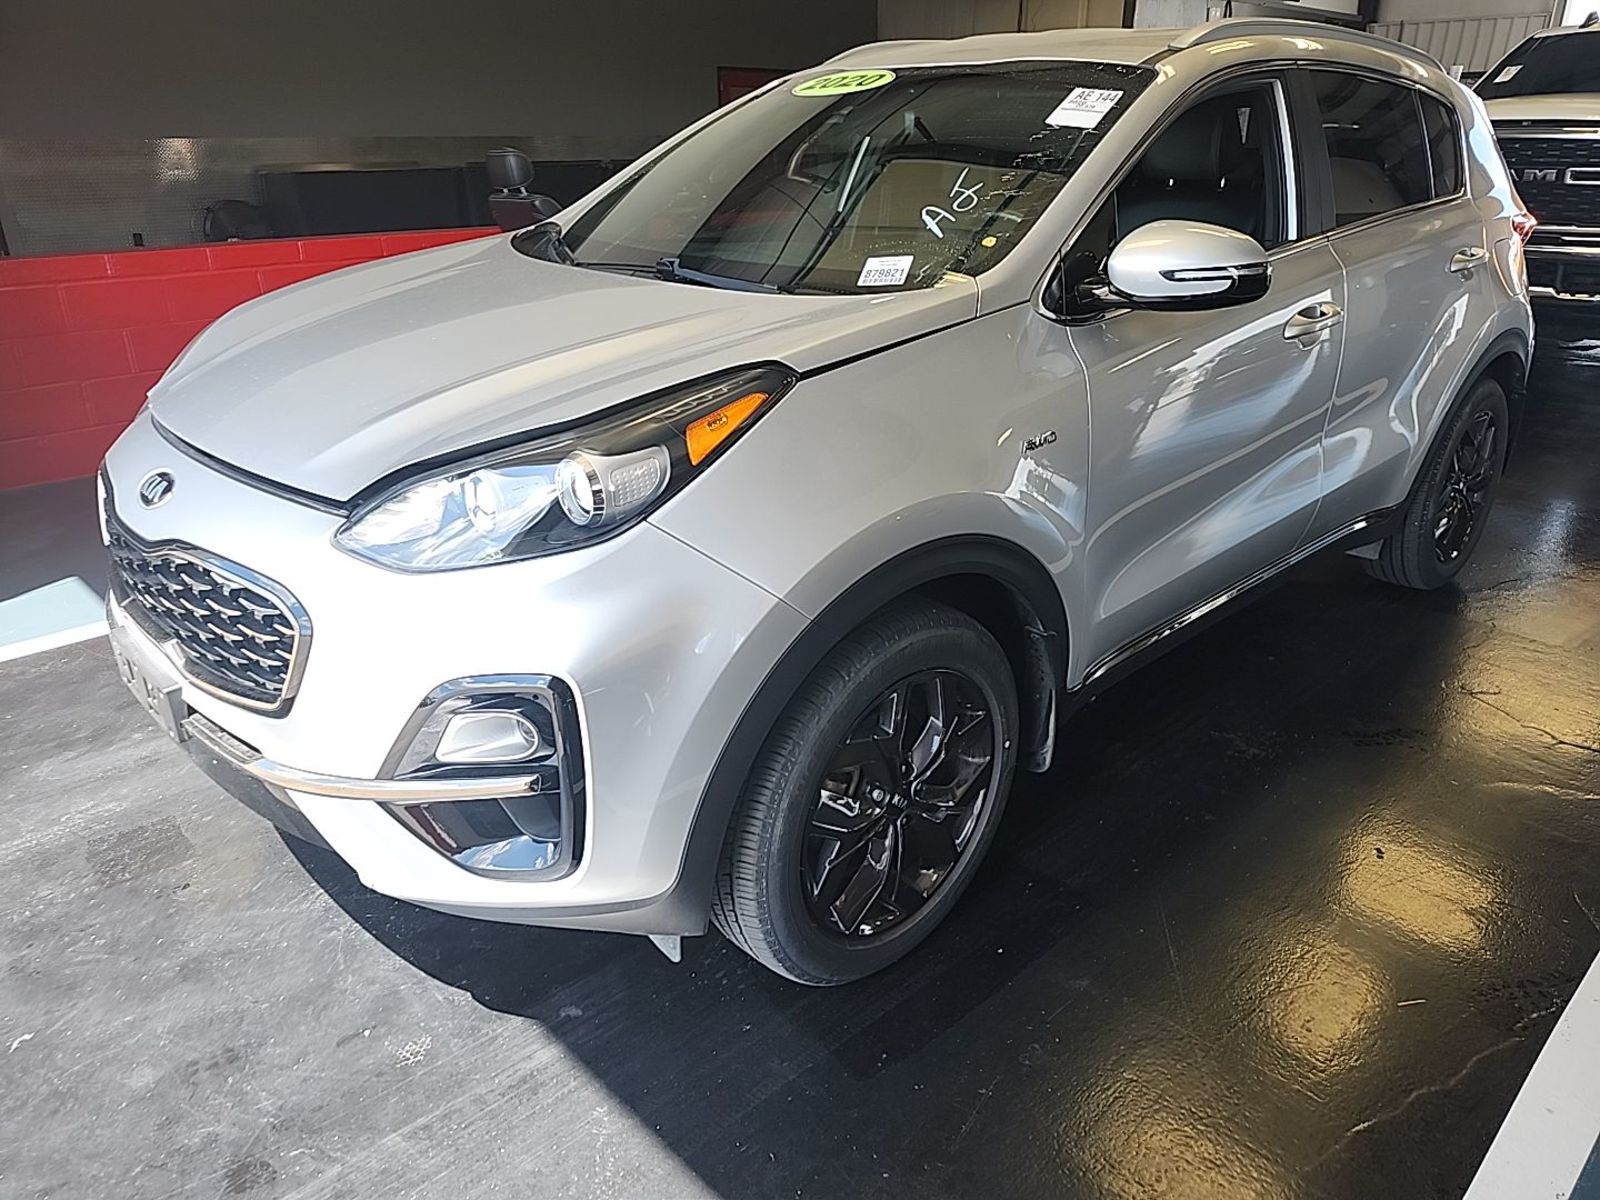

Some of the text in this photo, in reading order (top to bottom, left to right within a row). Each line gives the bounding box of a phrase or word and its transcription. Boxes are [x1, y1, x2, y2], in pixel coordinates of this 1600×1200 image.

[799, 74, 886, 91] 2020
[1074, 90, 1120, 103] AE 144
[864, 268, 905, 279] 879821
